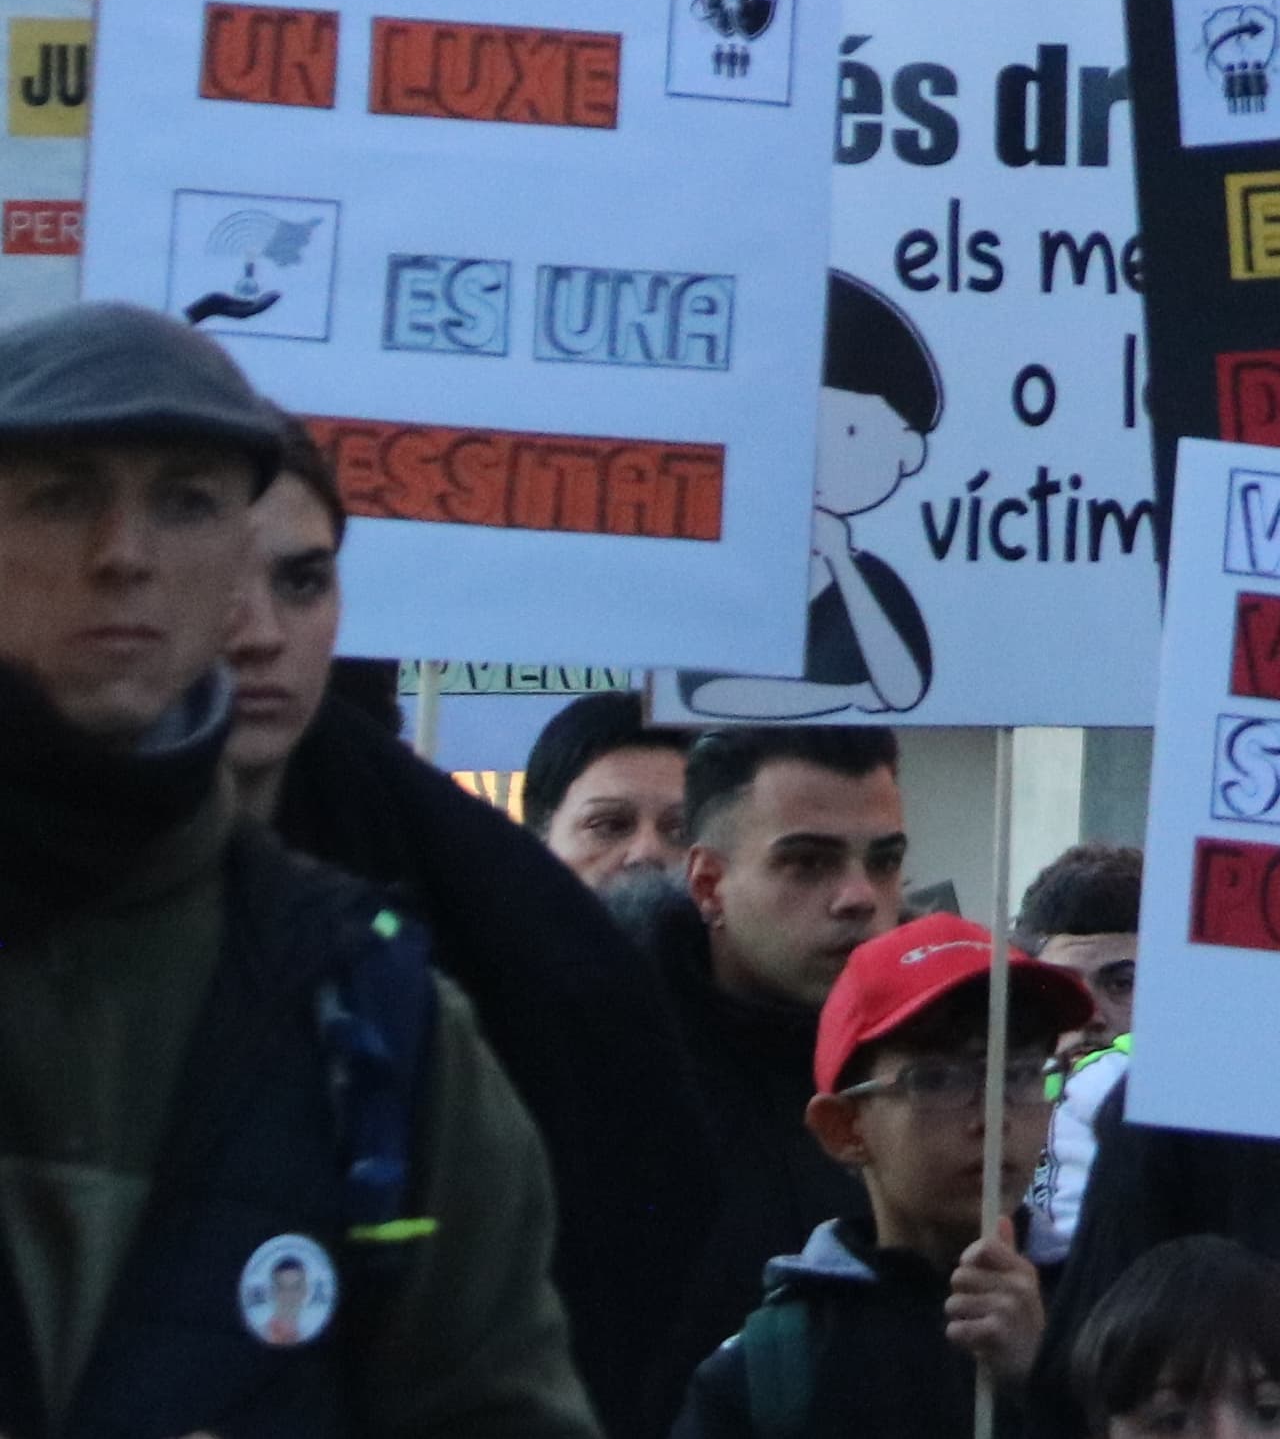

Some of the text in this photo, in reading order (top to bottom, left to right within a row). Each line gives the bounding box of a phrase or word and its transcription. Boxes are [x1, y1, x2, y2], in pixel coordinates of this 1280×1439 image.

[21, 43, 90, 108] JU
[205, 8, 617, 125] UN LUXE
[9, 211, 83, 243] PER
[894, 197, 1004, 294] els
[383, 256, 729, 364] ES UNA
[1012, 363, 1057, 427] o
[921, 465, 1156, 562] víctim
